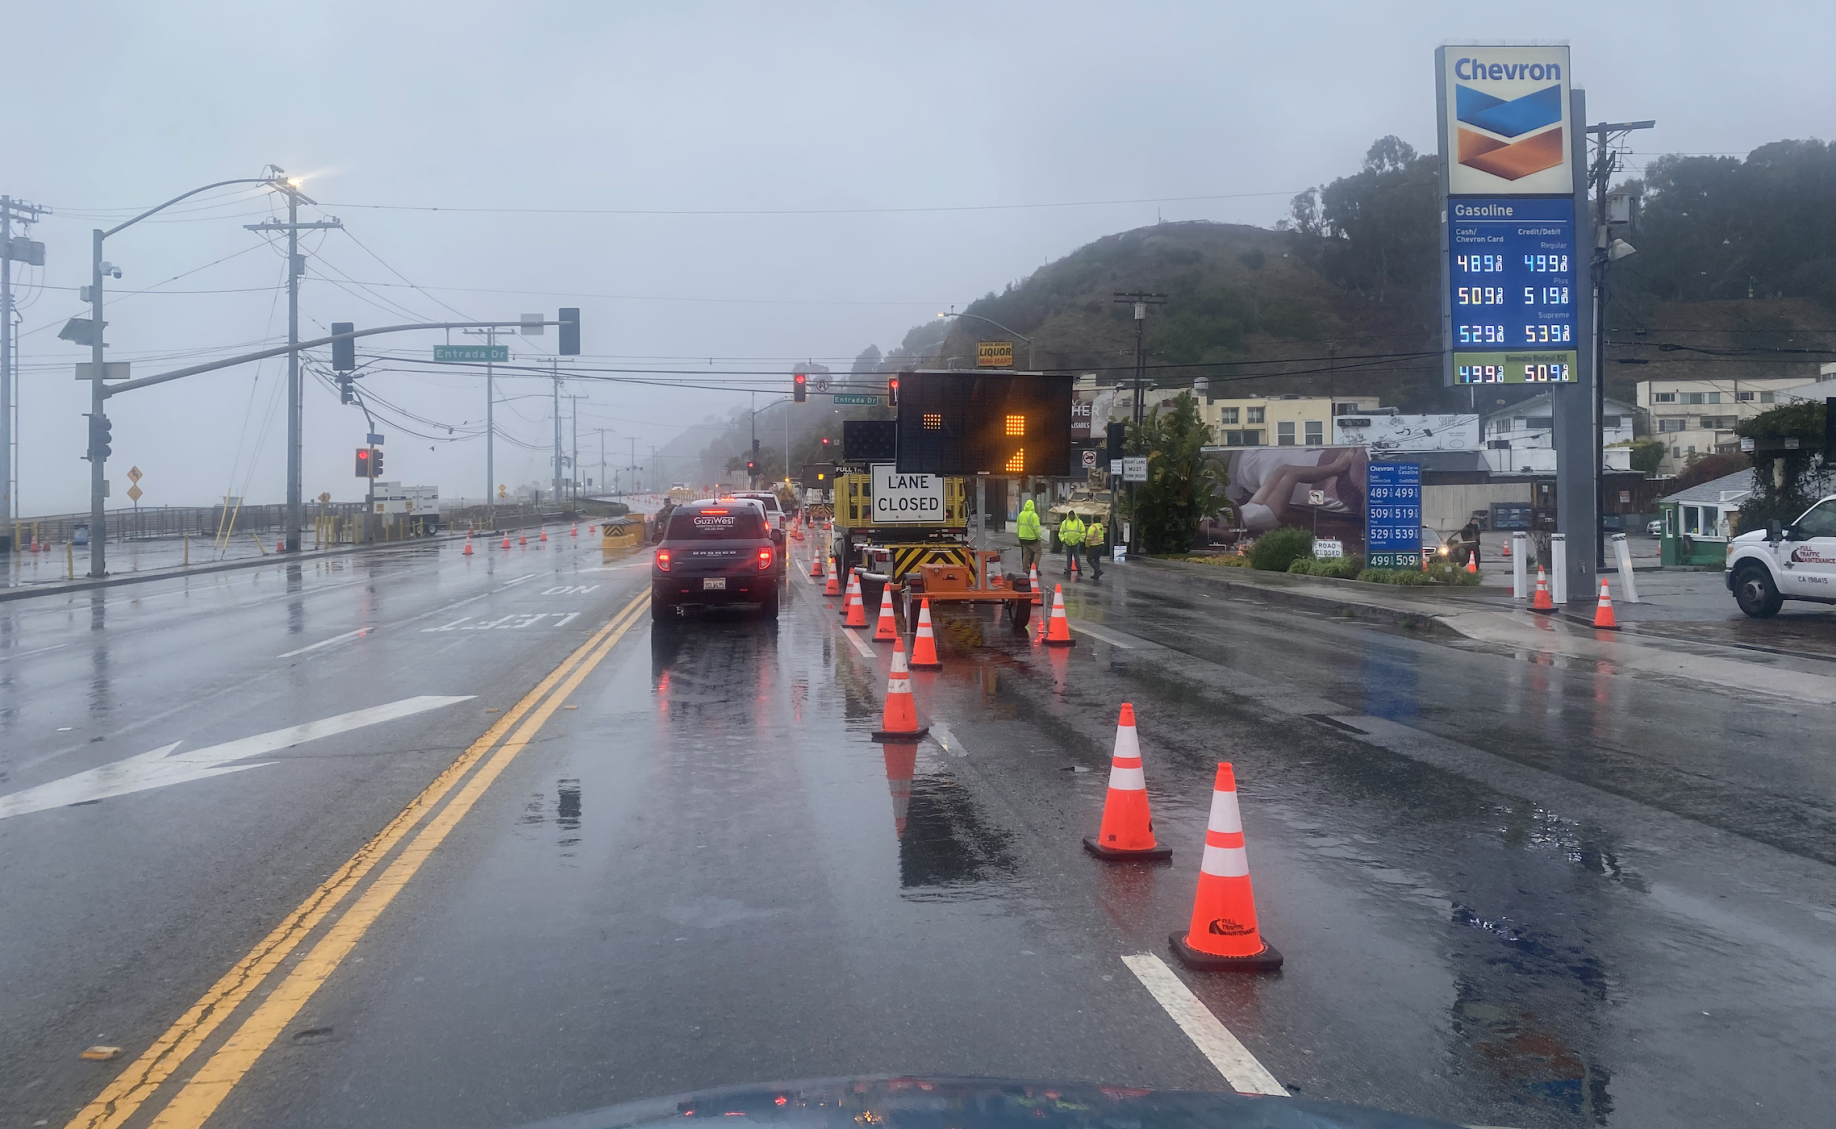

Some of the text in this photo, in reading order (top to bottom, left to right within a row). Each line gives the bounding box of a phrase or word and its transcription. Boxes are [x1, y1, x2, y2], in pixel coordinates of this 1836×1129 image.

[1455, 58, 1561, 80] Chevron
[1455, 204, 1513, 216] Gasoline
[1456, 228, 1477, 236] Cash/
[436, 350, 505, 358] Entrada Dr
[980, 348, 1011, 357] LIQUOR
[888, 476, 929, 489] LANE
[1370, 488, 1388, 498] 489
[1395, 488, 1414, 498] 499
[878, 498, 938, 511] CLOSED
[1371, 509, 1388, 518] 509
[1395, 509, 1414, 518] 519
[1371, 529, 1388, 539] 529
[1395, 529, 1414, 539] 539
[1371, 556, 1389, 565] 499
[1396, 555, 1415, 565] 509
